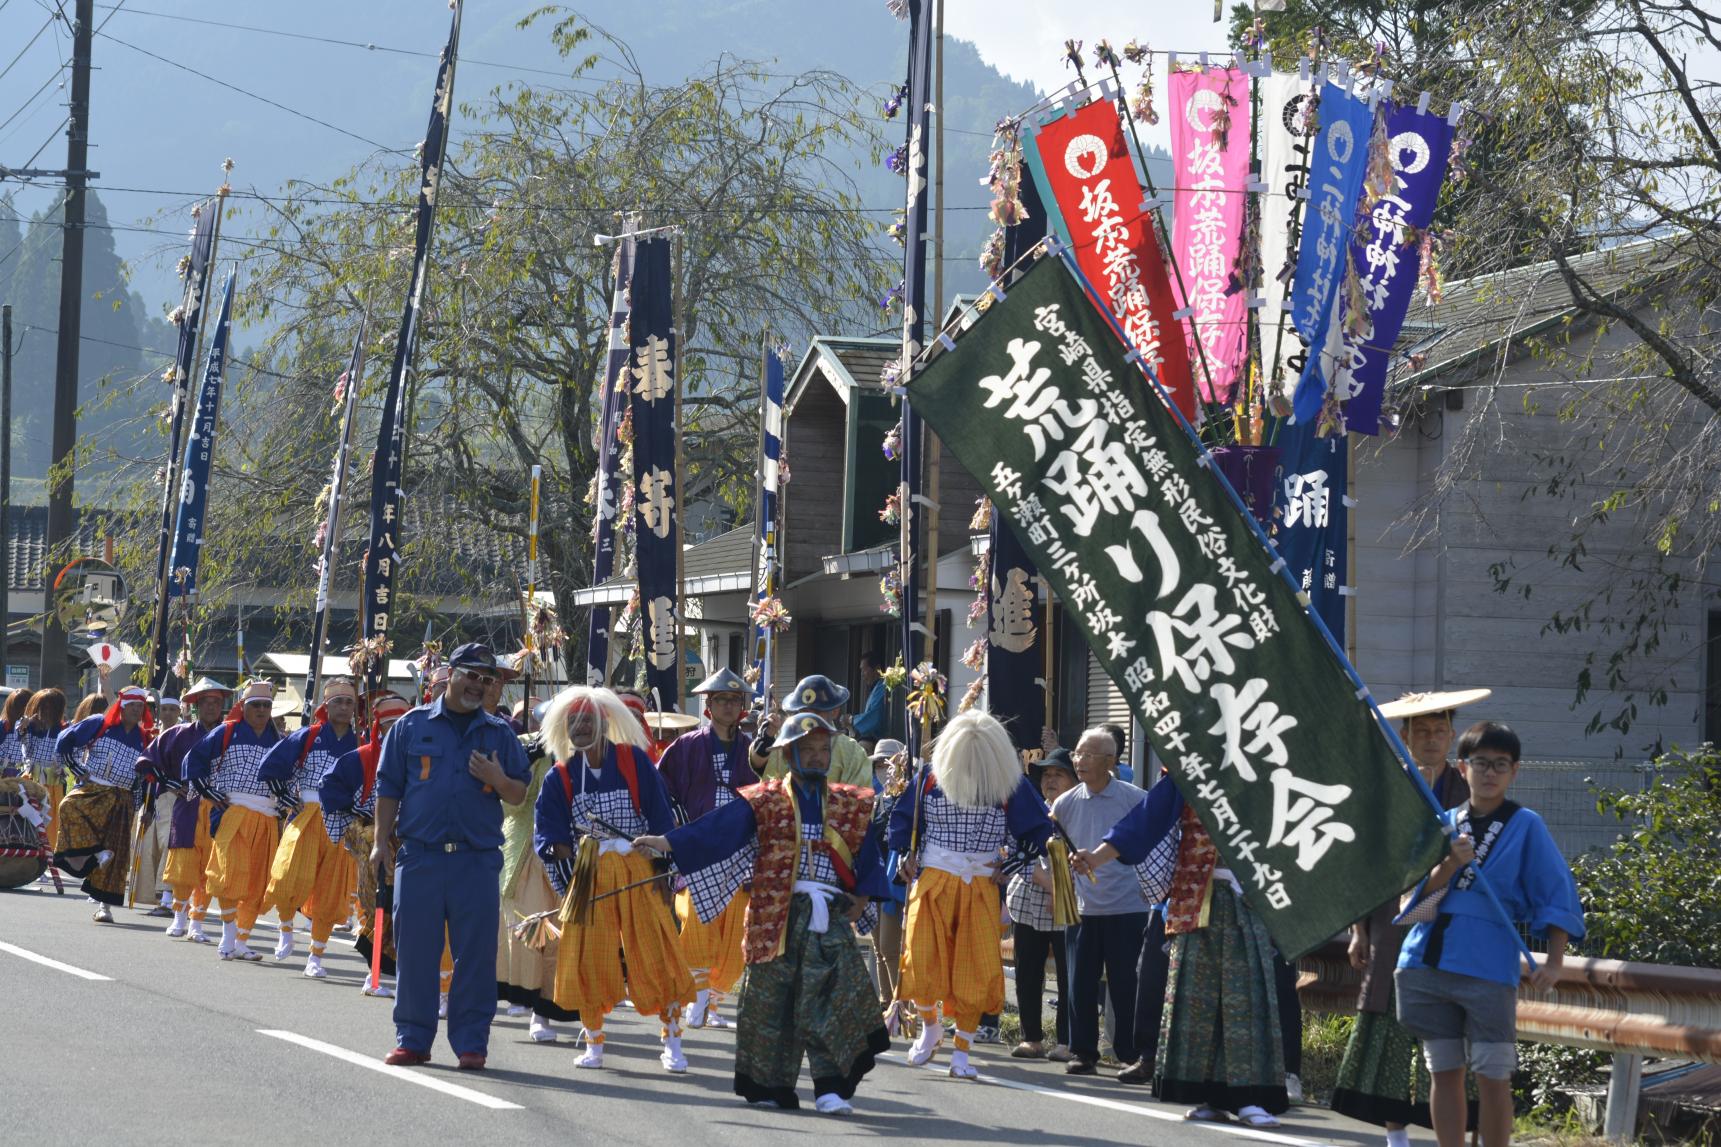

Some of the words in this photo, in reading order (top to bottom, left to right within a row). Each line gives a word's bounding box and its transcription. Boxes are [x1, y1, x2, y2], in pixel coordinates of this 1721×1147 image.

[201, 348, 220, 461] 平成七年十一月吉日
[1034, 304, 1280, 643] 宮崎県指定無形民俗文化財
[980, 338, 1356, 871] 荒踊り保存会
